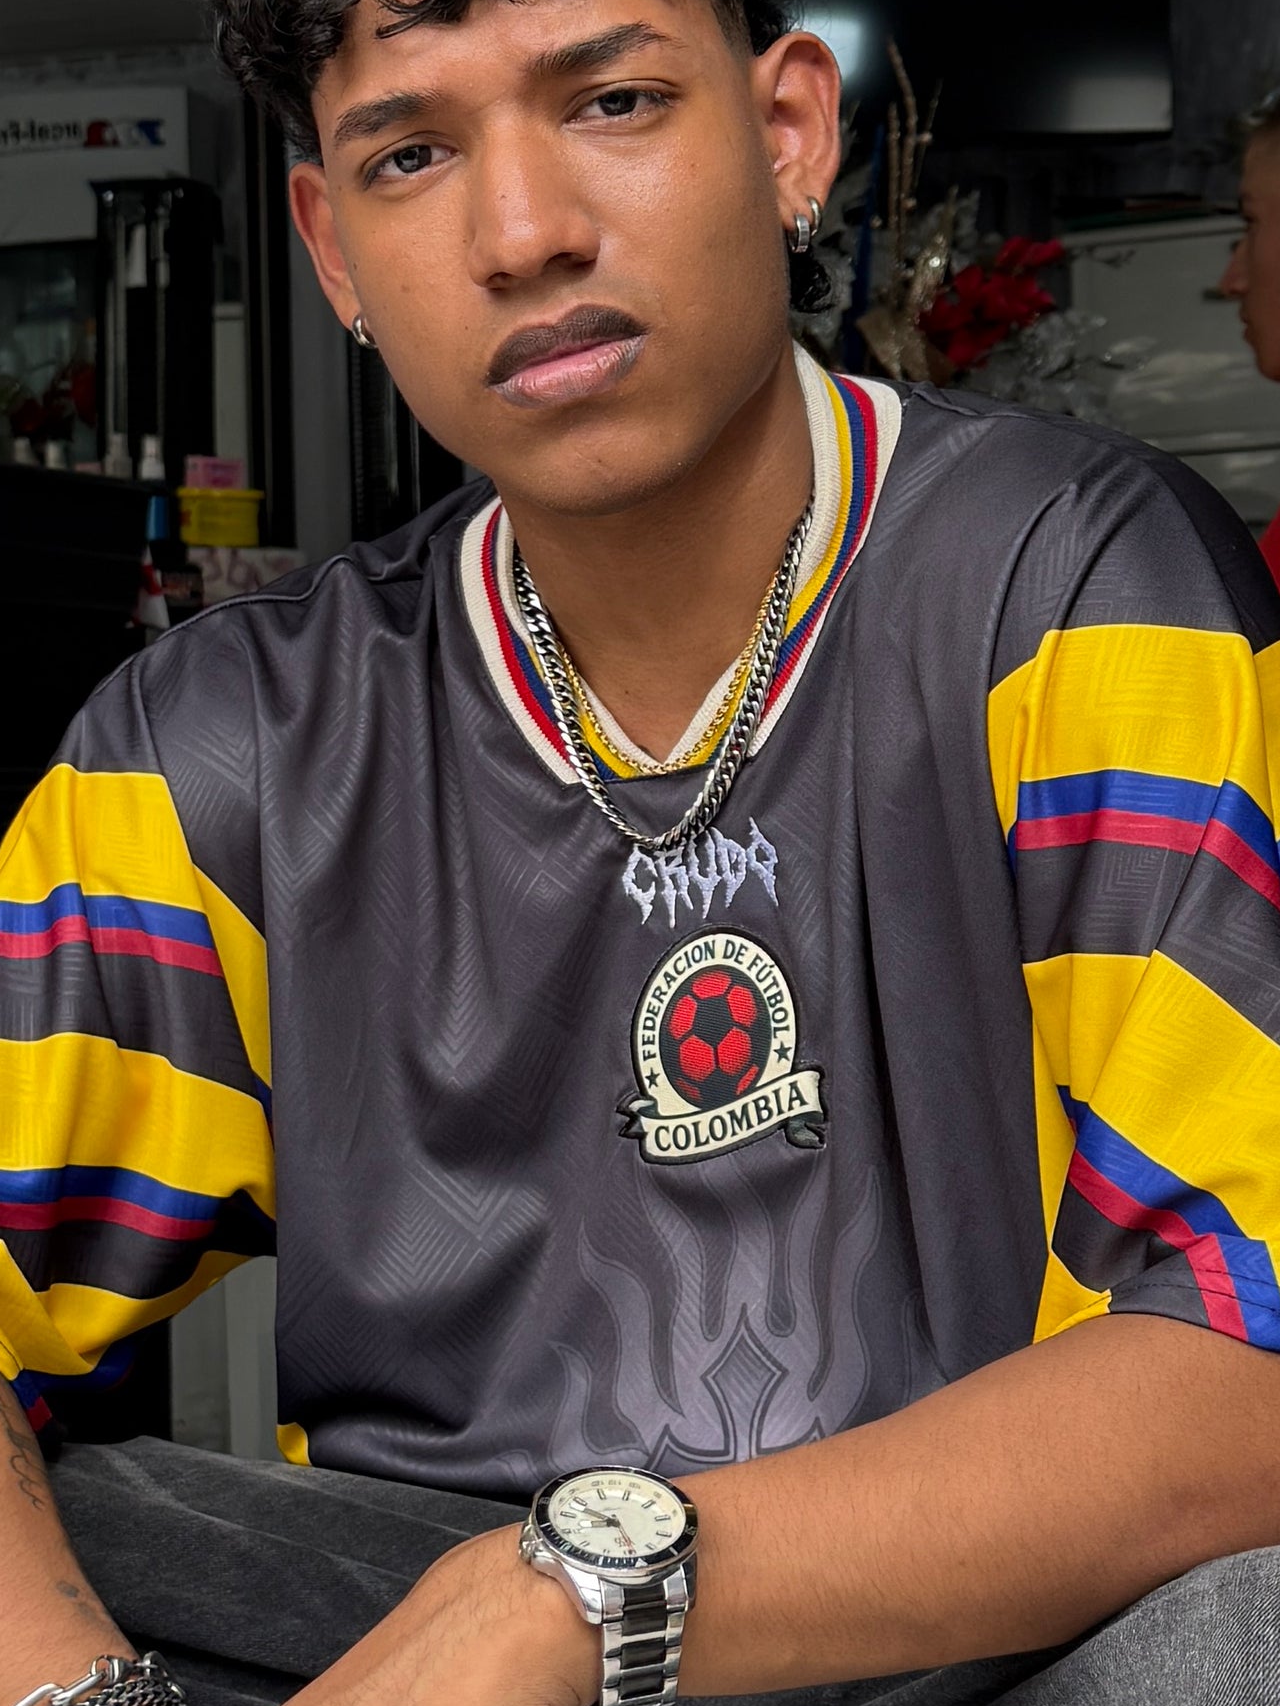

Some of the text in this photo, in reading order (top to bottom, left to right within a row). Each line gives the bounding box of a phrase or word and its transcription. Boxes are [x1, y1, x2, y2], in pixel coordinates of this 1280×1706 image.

[641, 939, 791, 1062] FEDERACION DE FÚTBOL
[654, 1080, 809, 1152] COLOMBIA
